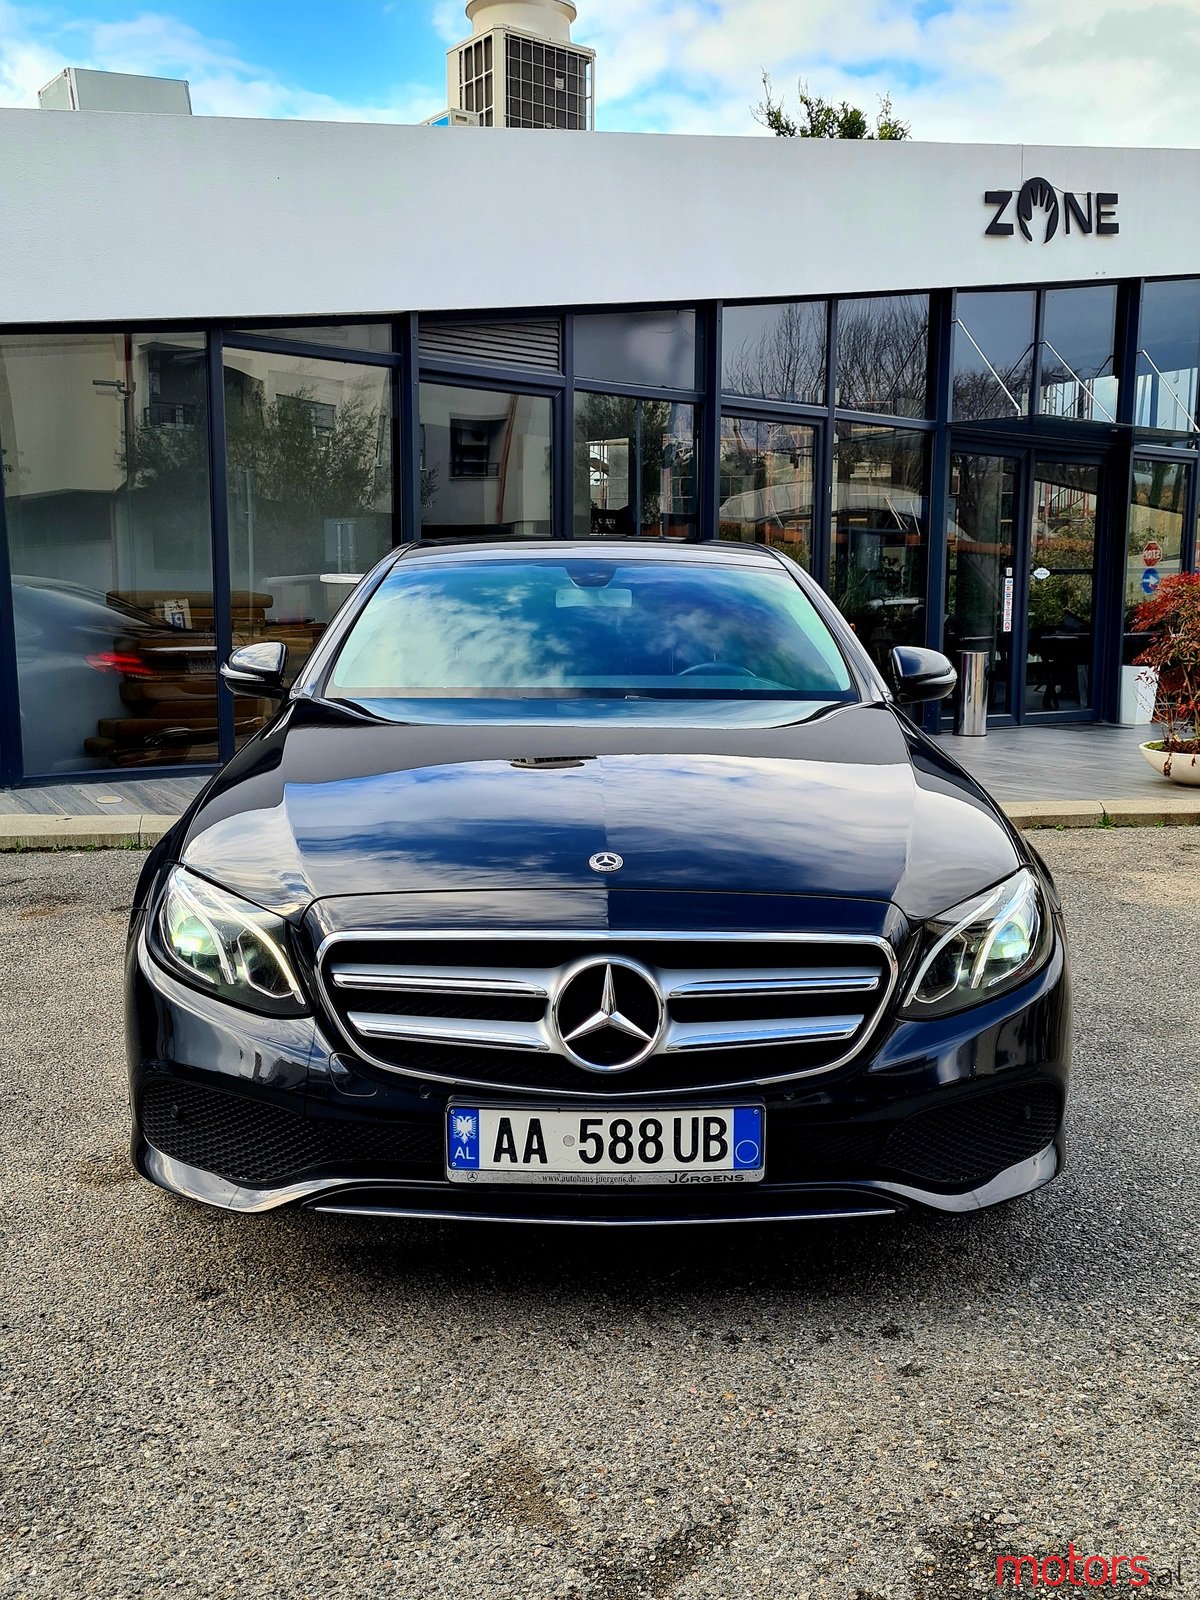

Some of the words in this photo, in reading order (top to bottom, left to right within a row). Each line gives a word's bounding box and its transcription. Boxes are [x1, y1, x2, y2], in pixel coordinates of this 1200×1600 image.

[984, 177, 1120, 244] ZONE
[454, 1146, 475, 1160] AL
[492, 1117, 548, 1164] AA
